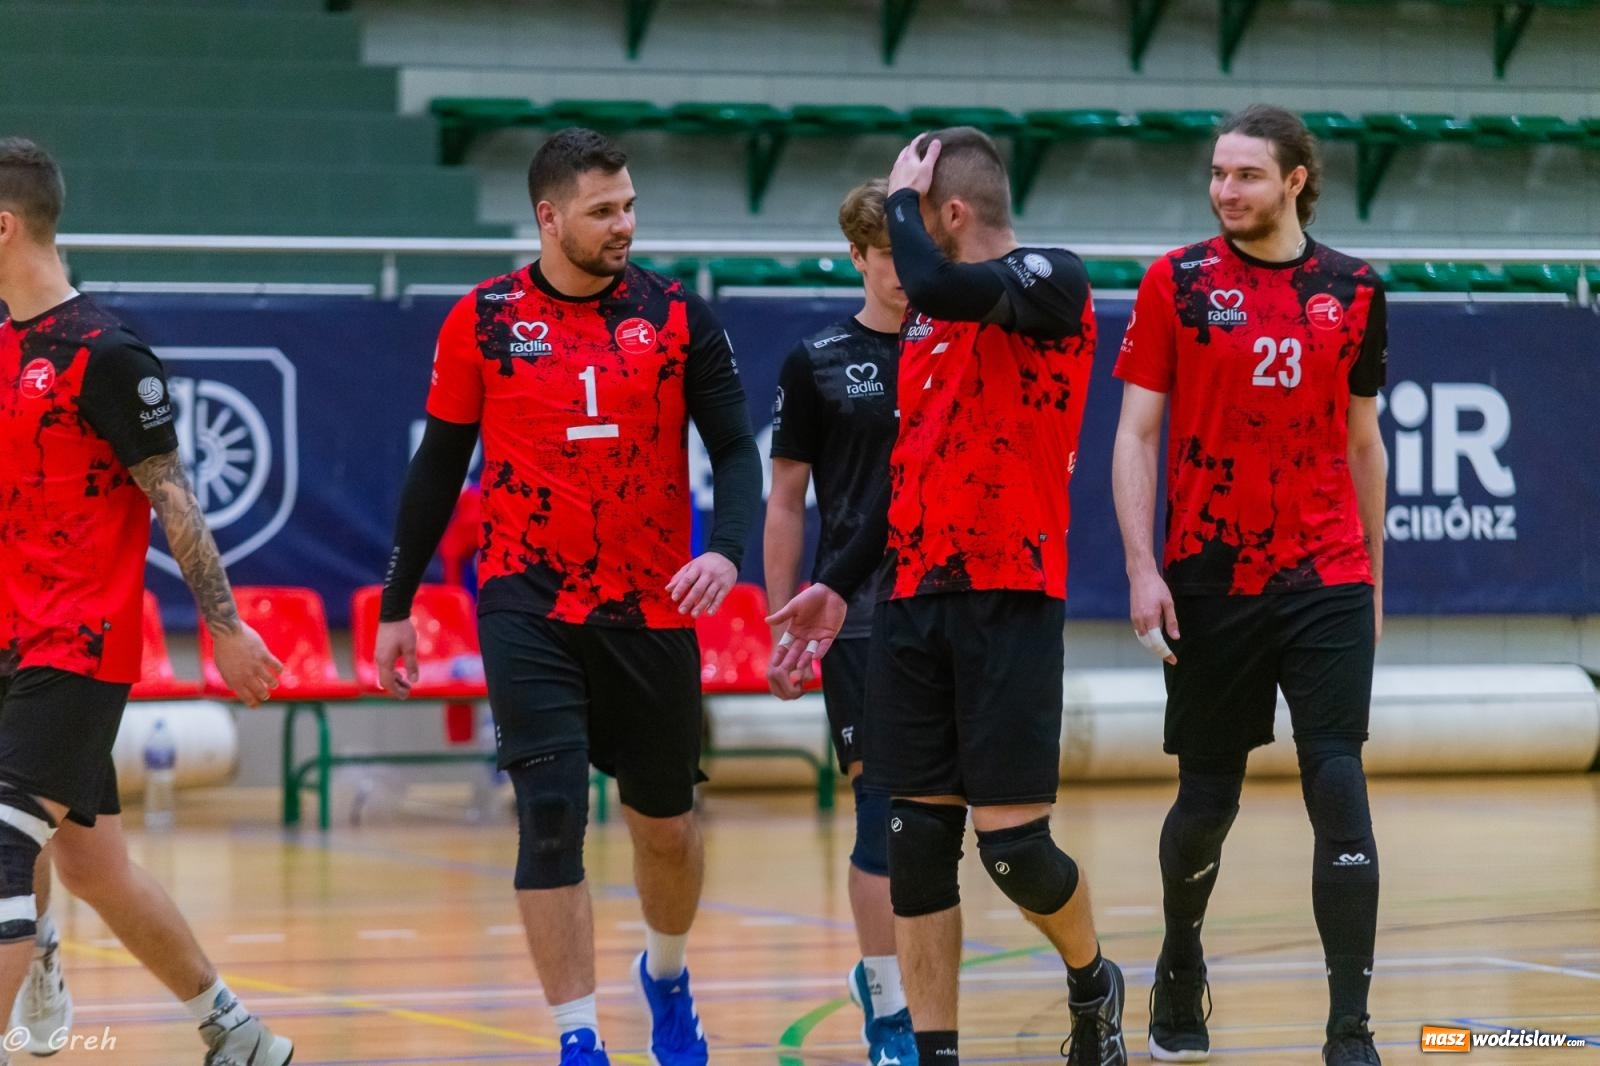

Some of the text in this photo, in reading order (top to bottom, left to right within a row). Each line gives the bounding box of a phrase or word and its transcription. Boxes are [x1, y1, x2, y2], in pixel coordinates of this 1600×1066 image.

[1207, 308, 1248, 321] radlin
[907, 323, 934, 337] radlin
[510, 340, 553, 353] radlin
[1252, 336, 1302, 389] 23
[578, 365, 599, 417] 1
[846, 379, 885, 394] radlin
[1376, 380, 1517, 498] iR
[1383, 495, 1517, 541] CIBÓRZ
